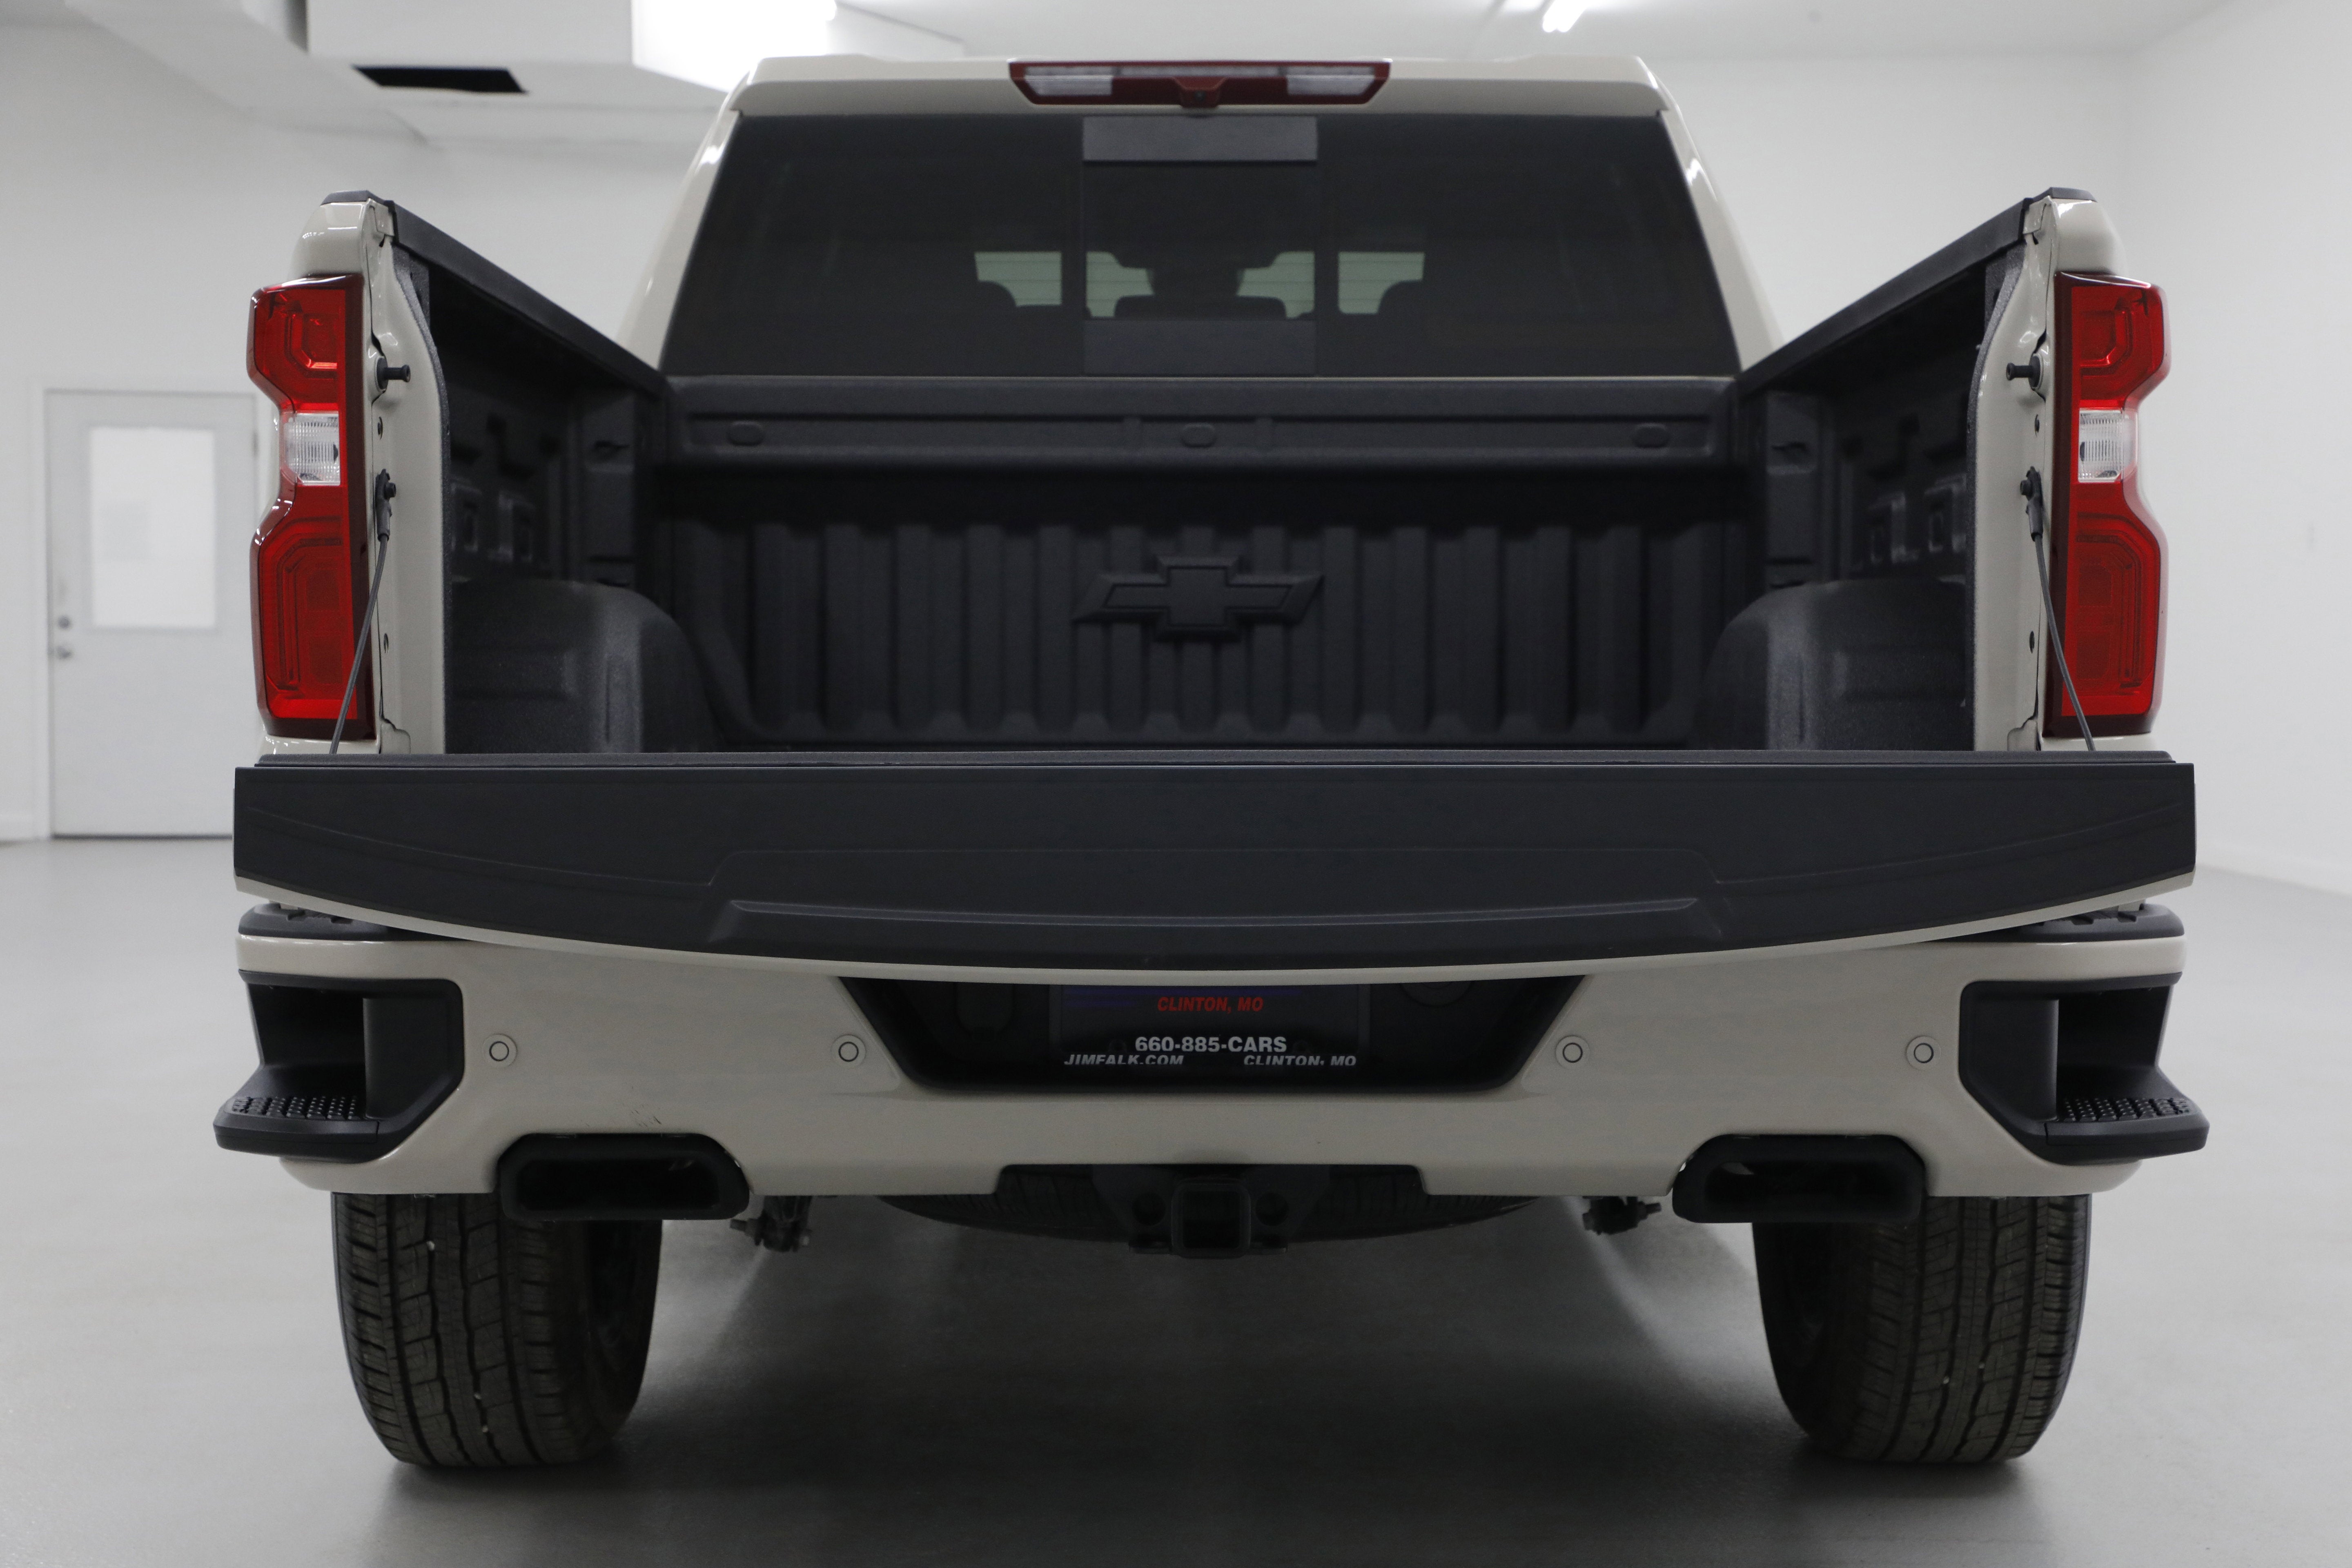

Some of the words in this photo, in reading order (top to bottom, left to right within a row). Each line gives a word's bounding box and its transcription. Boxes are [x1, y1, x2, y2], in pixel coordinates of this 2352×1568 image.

[1157, 997, 1232, 1014] CLINTON,
[1237, 997, 1264, 1011] MO
[1135, 1036, 1287, 1052] 660-885-CARS
[1064, 1054, 1184, 1065] JIMFALK.COM
[1244, 1055, 1325, 1066] CLINTON,
[1330, 1056, 1356, 1066] MO
